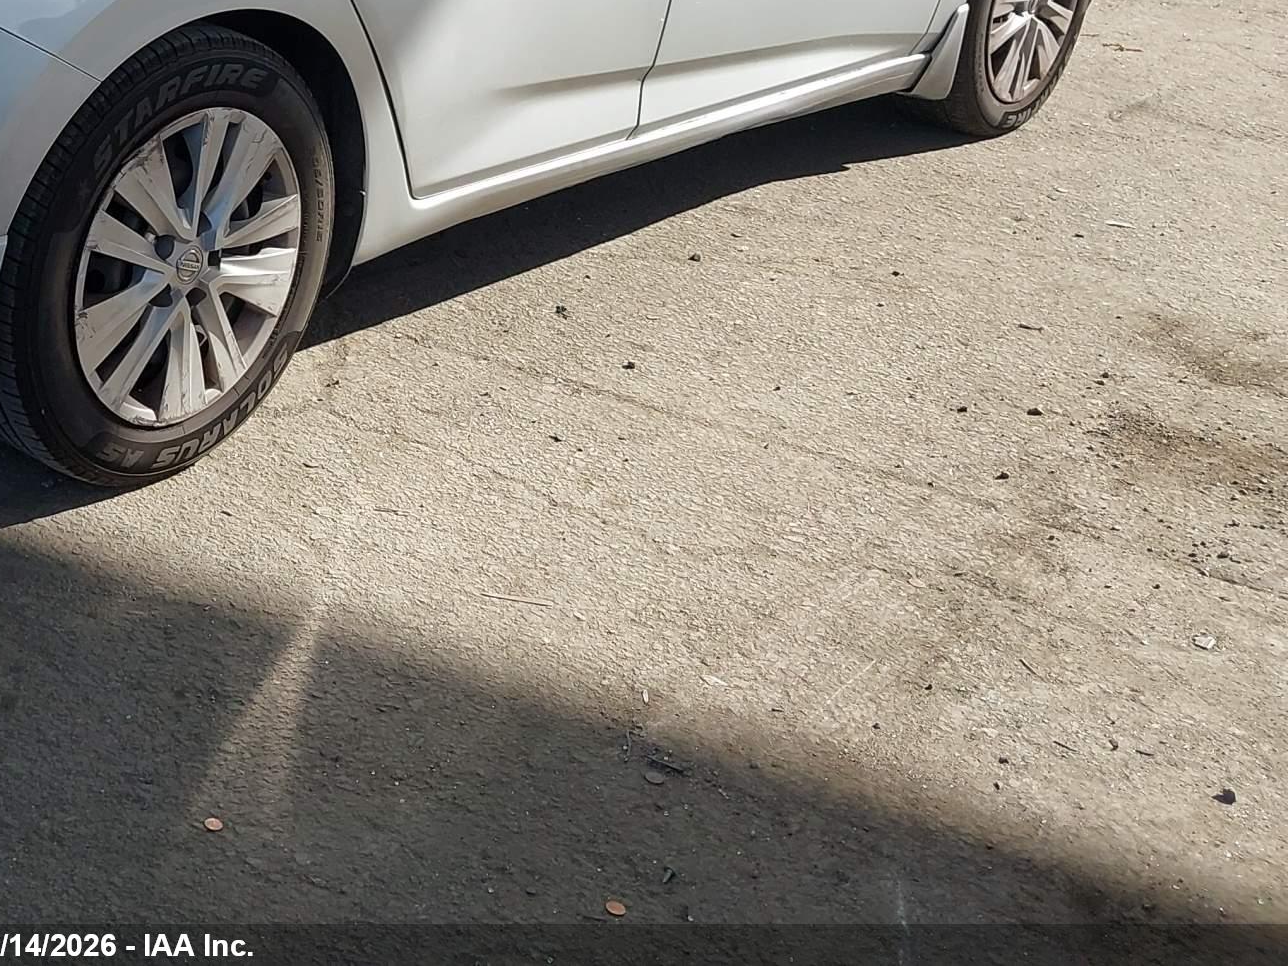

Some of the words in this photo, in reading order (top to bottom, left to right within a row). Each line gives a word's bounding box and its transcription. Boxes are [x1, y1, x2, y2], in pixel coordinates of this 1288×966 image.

[91, 63, 268, 178] STARFIRE
[95, 442, 145, 468] AS
[151, 342, 288, 468] SOLARUS
